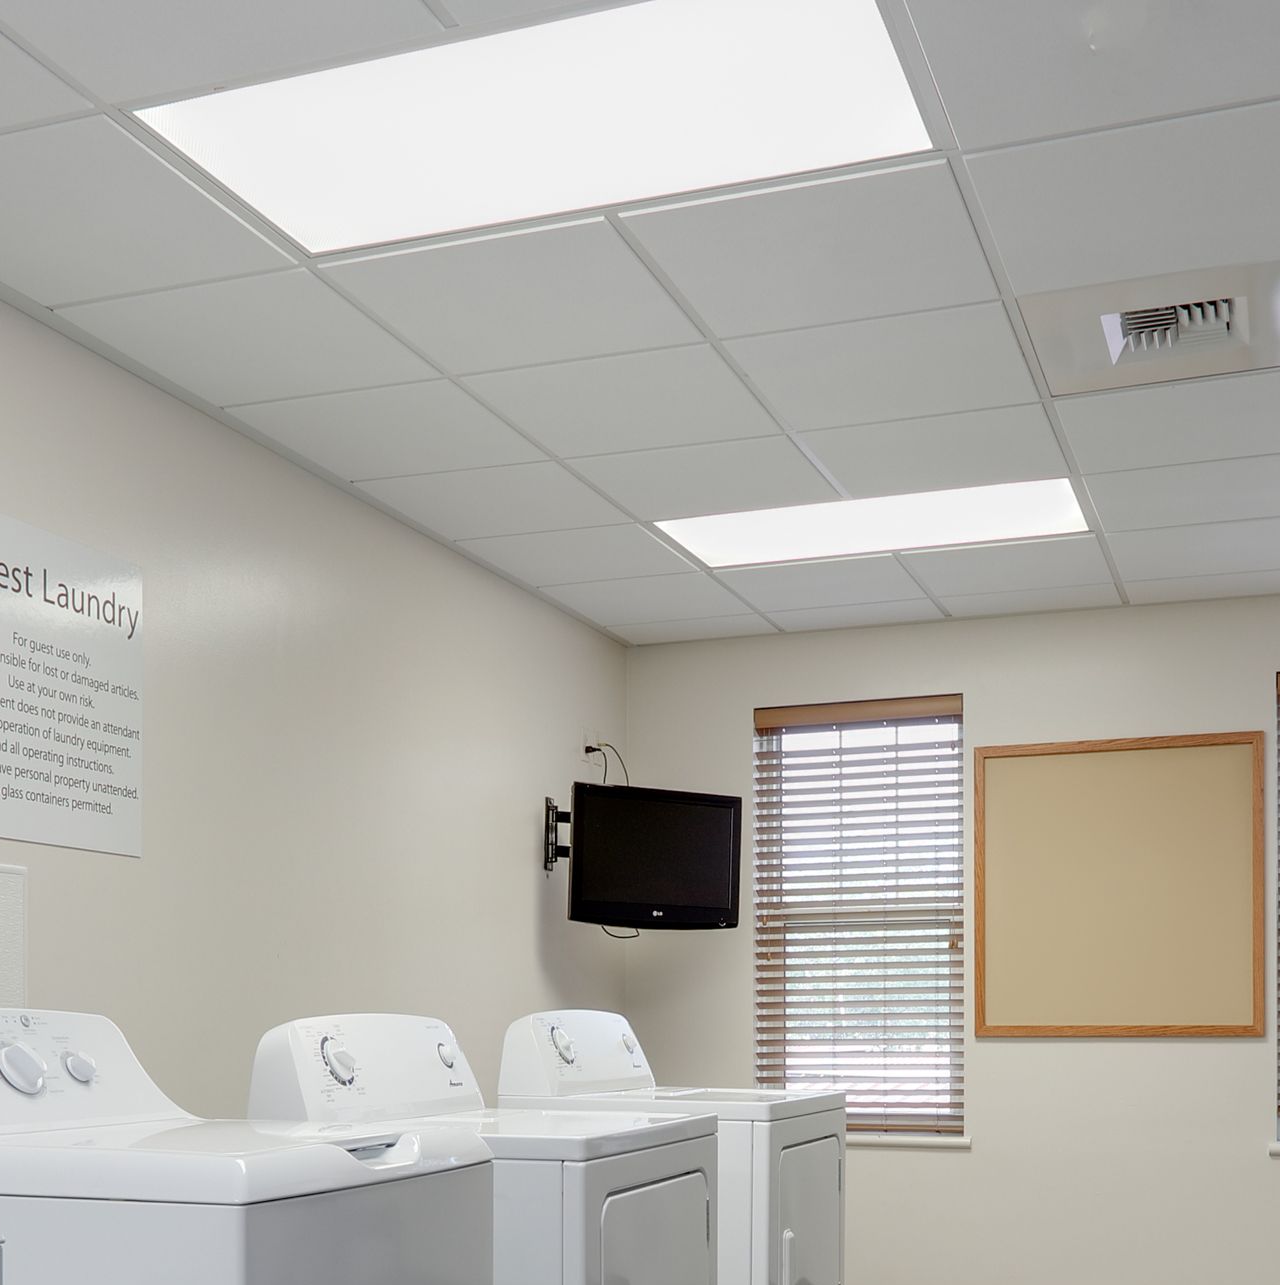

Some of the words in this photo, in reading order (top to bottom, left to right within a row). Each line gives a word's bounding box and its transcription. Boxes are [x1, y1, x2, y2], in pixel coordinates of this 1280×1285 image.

[43, 568, 138, 640] Laundry
[12, 631, 27, 648] For
[29, 639, 54, 656] guest
[55, 647, 71, 661] use
[72, 652, 91, 669] only.
[8, 674, 25, 691] Use
[26, 681, 35, 694] at
[37, 685, 57, 698] your
[59, 690, 78, 704] own
[79, 694, 95, 709] risk.
[28, 657, 41, 673] for
[42, 661, 58, 678] lost
[60, 670, 69, 681] or
[71, 671, 109, 692] damaged
[110, 683, 139, 701] articles.
[17, 699, 39, 716] does
[41, 707, 56, 720] not
[58, 712, 89, 728] provide
[90, 720, 101, 731] an
[102, 722, 140, 740] attendant
[9, 741, 20, 756] all
[22, 746, 64, 767] operating
[66, 752, 115, 775] instructions.
[42, 727, 52, 740] of
[53, 728, 85, 751] laundry
[86, 739, 132, 758] equipment.
[1, 784, 24, 800] glass
[25, 790, 70, 808] containers
[71, 799, 114, 815] permitted.
[14, 766, 52, 783] personal
[54, 773, 91, 793] property
[92, 780, 139, 800] unattended.
